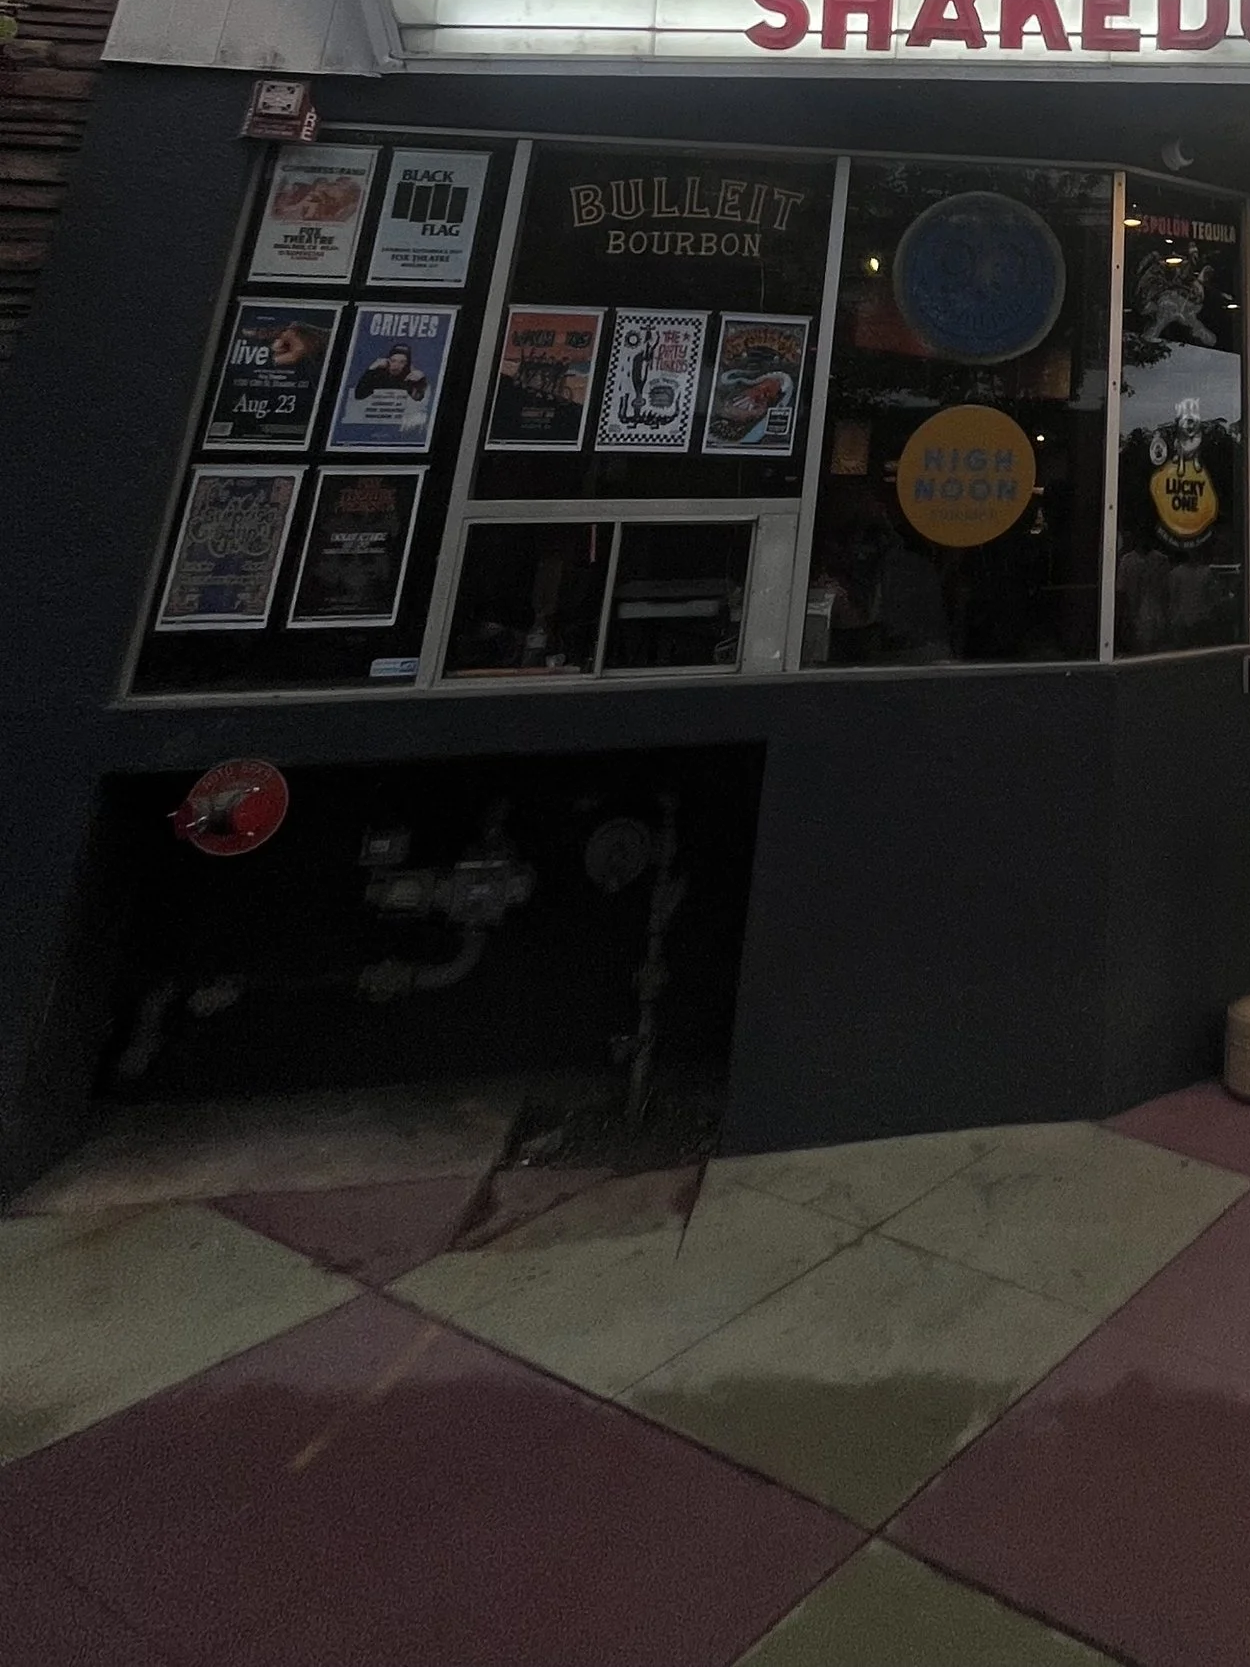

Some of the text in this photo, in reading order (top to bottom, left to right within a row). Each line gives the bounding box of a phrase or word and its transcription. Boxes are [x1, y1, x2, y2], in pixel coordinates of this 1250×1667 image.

[402, 169, 455, 183] BLACK
[570, 176, 805, 231] BULLEIT
[421, 224, 460, 237] FLAG
[1191, 220, 1237, 243] TEQUILA
[606, 231, 762, 257] BOURBON
[370, 313, 440, 338] GRIEVES
[229, 338, 270, 366] live
[232, 393, 297, 419] Aug. 23
[923, 448, 1017, 472] HIGH
[914, 478, 1018, 502] NOON
[1166, 478, 1205, 497] LUCKY
[1172, 496, 1199, 512] ONE
